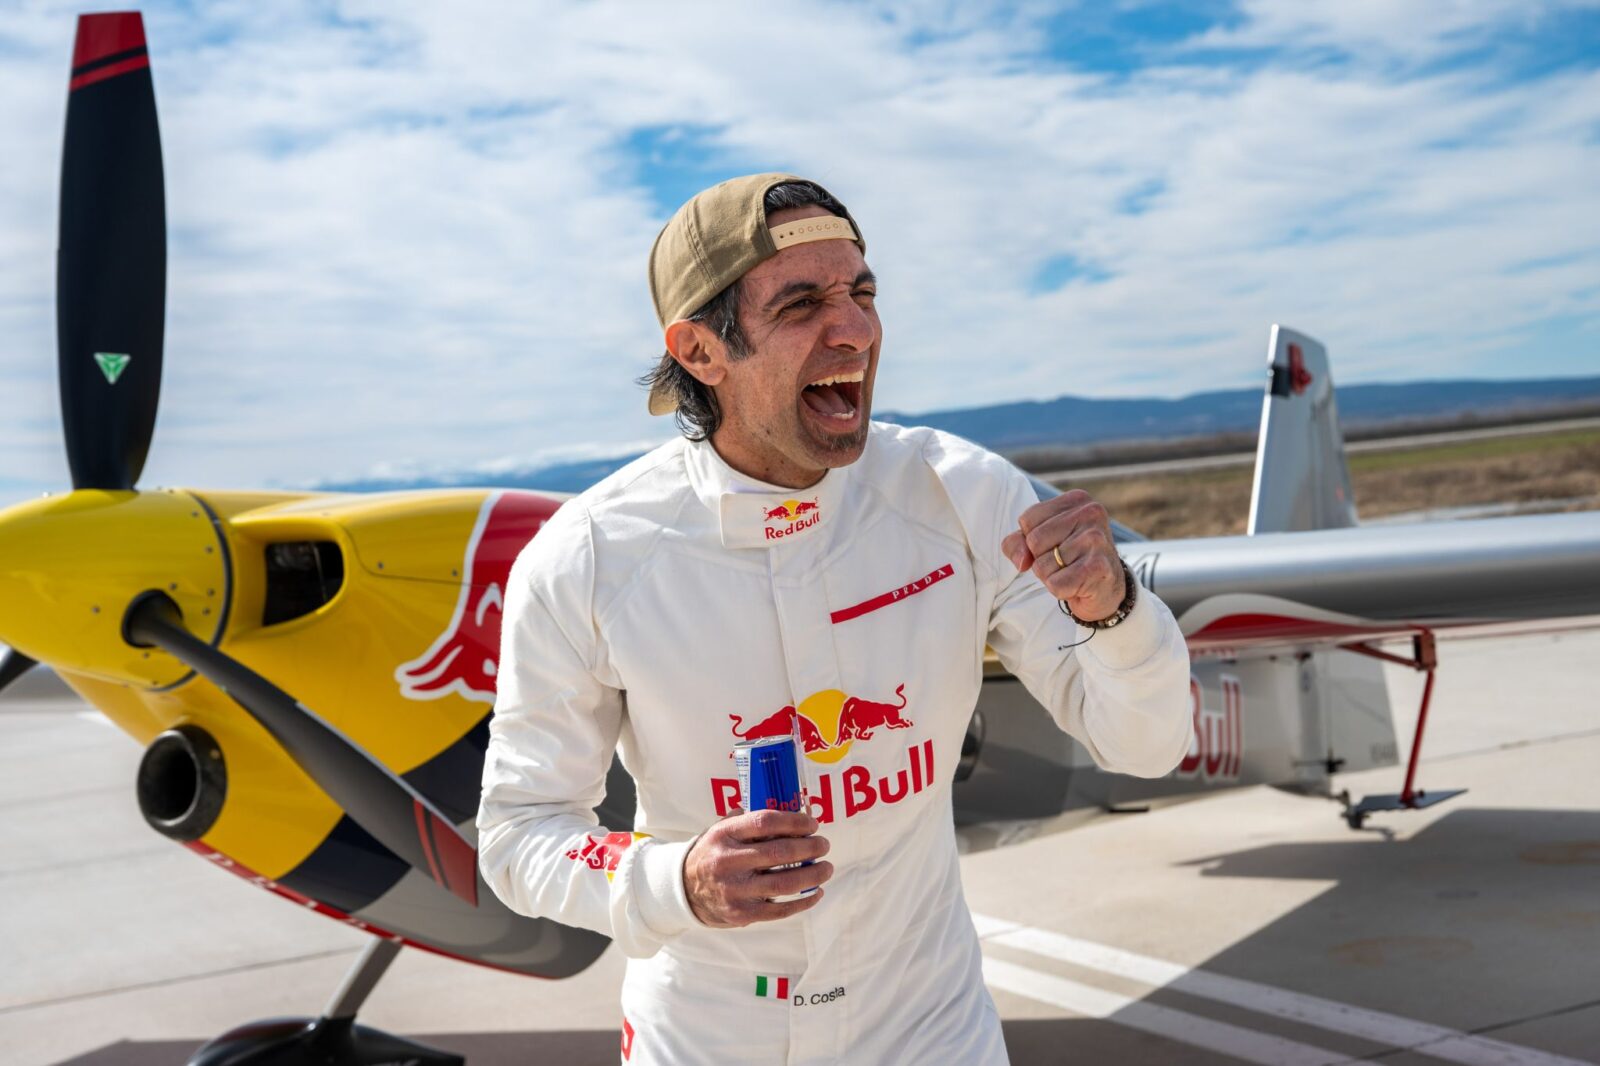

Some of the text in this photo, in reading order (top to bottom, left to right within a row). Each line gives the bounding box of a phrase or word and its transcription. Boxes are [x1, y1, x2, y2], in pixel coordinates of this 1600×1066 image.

[765, 512, 820, 540] Red Bull
[892, 569, 947, 600] PRADA
[711, 774, 834, 824] Rd
[842, 739, 934, 819] Bull
[794, 986, 846, 1007] D. Costa
